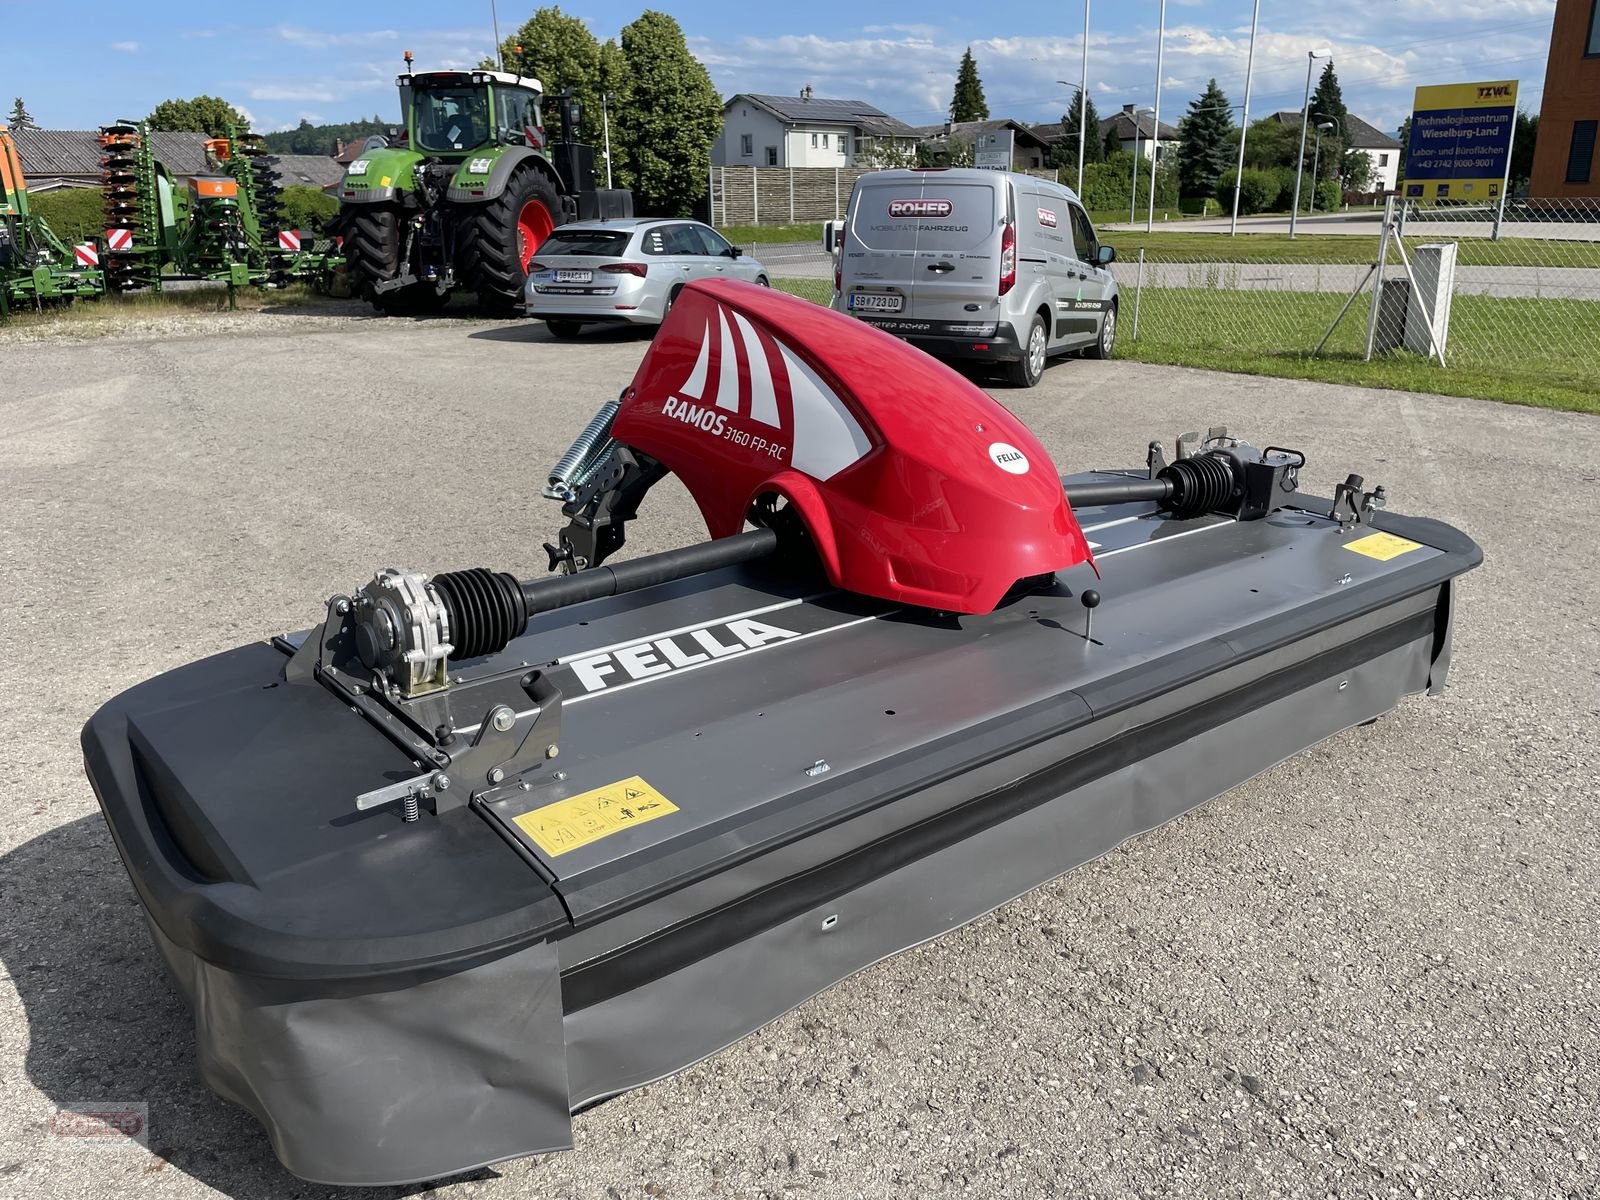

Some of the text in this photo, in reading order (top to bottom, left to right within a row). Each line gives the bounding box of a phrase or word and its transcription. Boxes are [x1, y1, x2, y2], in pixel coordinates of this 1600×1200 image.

[1477, 86, 1511, 98] TZWL
[1416, 114, 1509, 126] Technologiezentrum
[1422, 126, 1499, 139] Wieselburg-Land
[1412, 145, 1504, 157] Labor- und Büroflächen
[1417, 158, 1494, 168] +43 2742 9000-9001
[890, 202, 950, 216] ROHER
[869, 223, 969, 233] MOBILITÄTSFAHRZEUG
[855, 296, 899, 308] SB 723 DD
[865, 321, 897, 329] ENTER
[899, 322, 931, 330] ROHER
[661, 396, 787, 461] RAMOS 3160 FP-RC
[995, 451, 1024, 464] FELLA
[569, 618, 802, 692] FELLA
